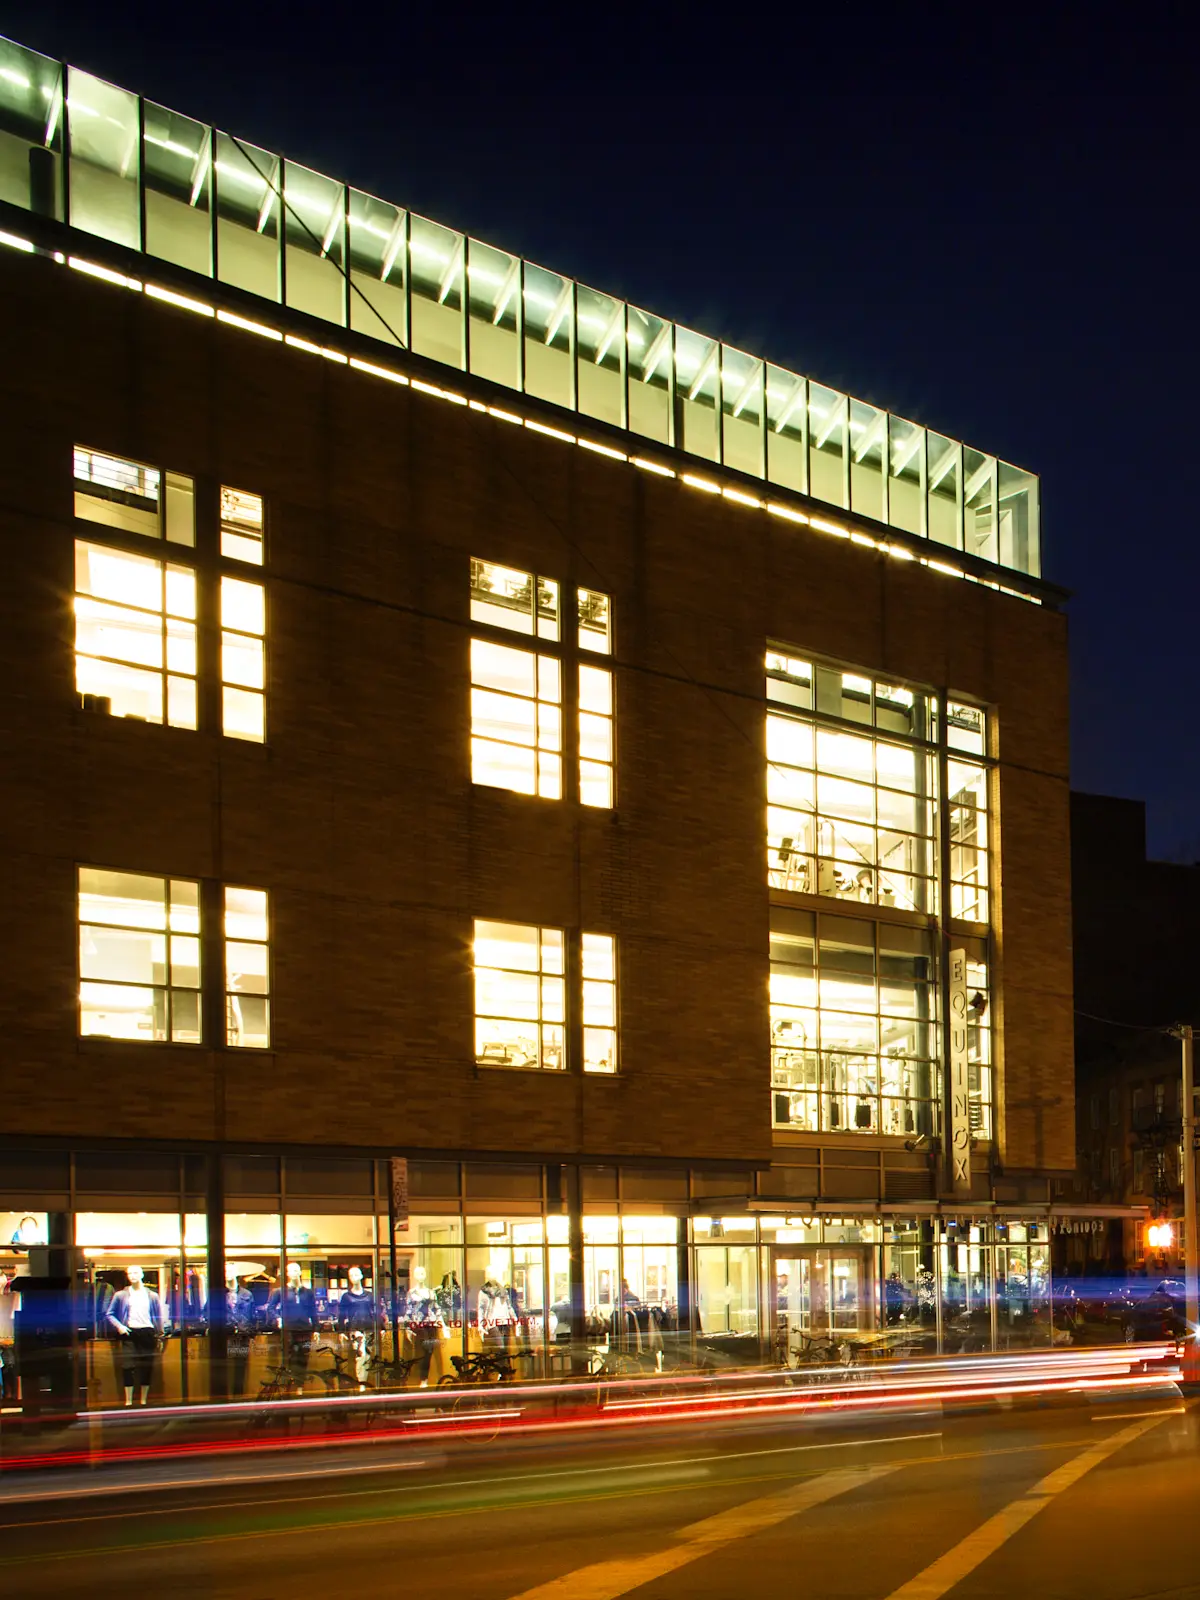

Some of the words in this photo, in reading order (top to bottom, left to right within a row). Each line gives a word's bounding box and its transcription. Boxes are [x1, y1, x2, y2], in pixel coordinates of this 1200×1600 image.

[952, 959, 968, 1181] EQUINOX
[785, 1211, 901, 1229] EQUINOX
[448, 1319, 462, 1328] TO
[470, 1318, 501, 1328] MOVE
